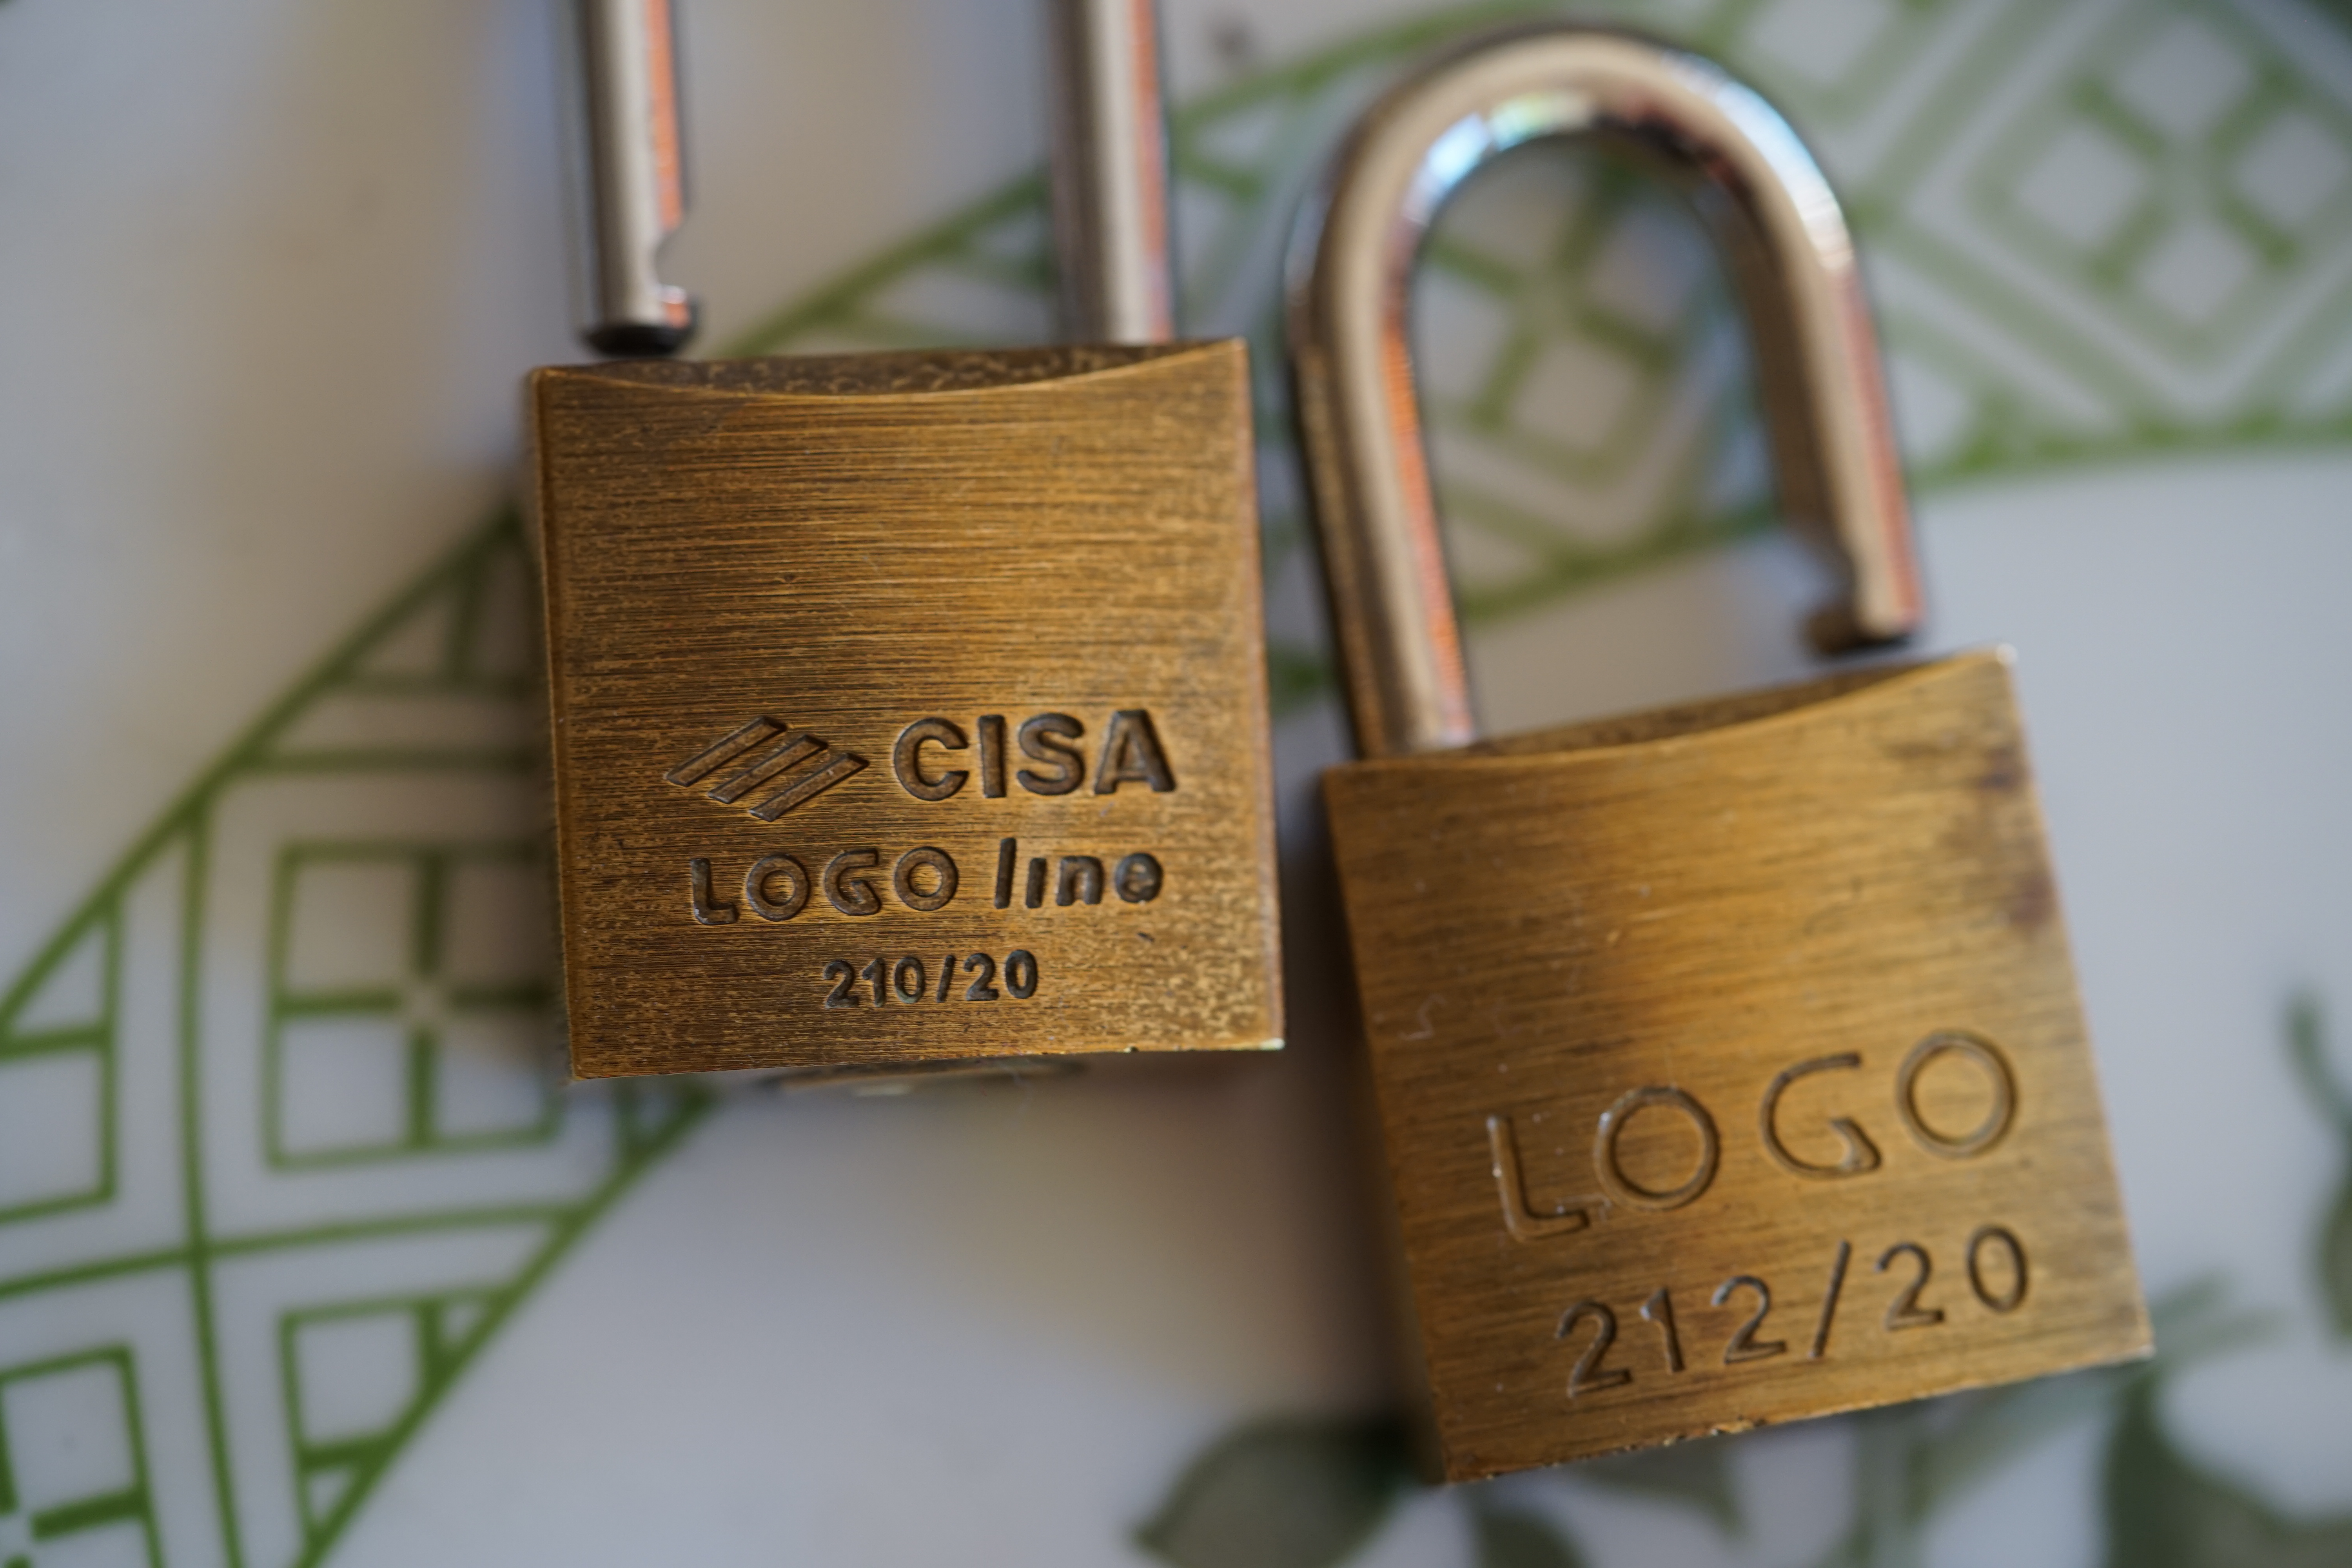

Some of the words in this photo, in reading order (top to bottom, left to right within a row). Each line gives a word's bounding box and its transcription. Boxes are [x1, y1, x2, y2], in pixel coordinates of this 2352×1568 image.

[893, 709, 1177, 801] CISA
[690, 846, 959, 925] LOGO
[994, 837, 1163, 909] line
[823, 949, 1038, 1009] 210/20
[1486, 1028, 2018, 1242] LOGO
[1555, 1224, 2028, 1399] 212/20
